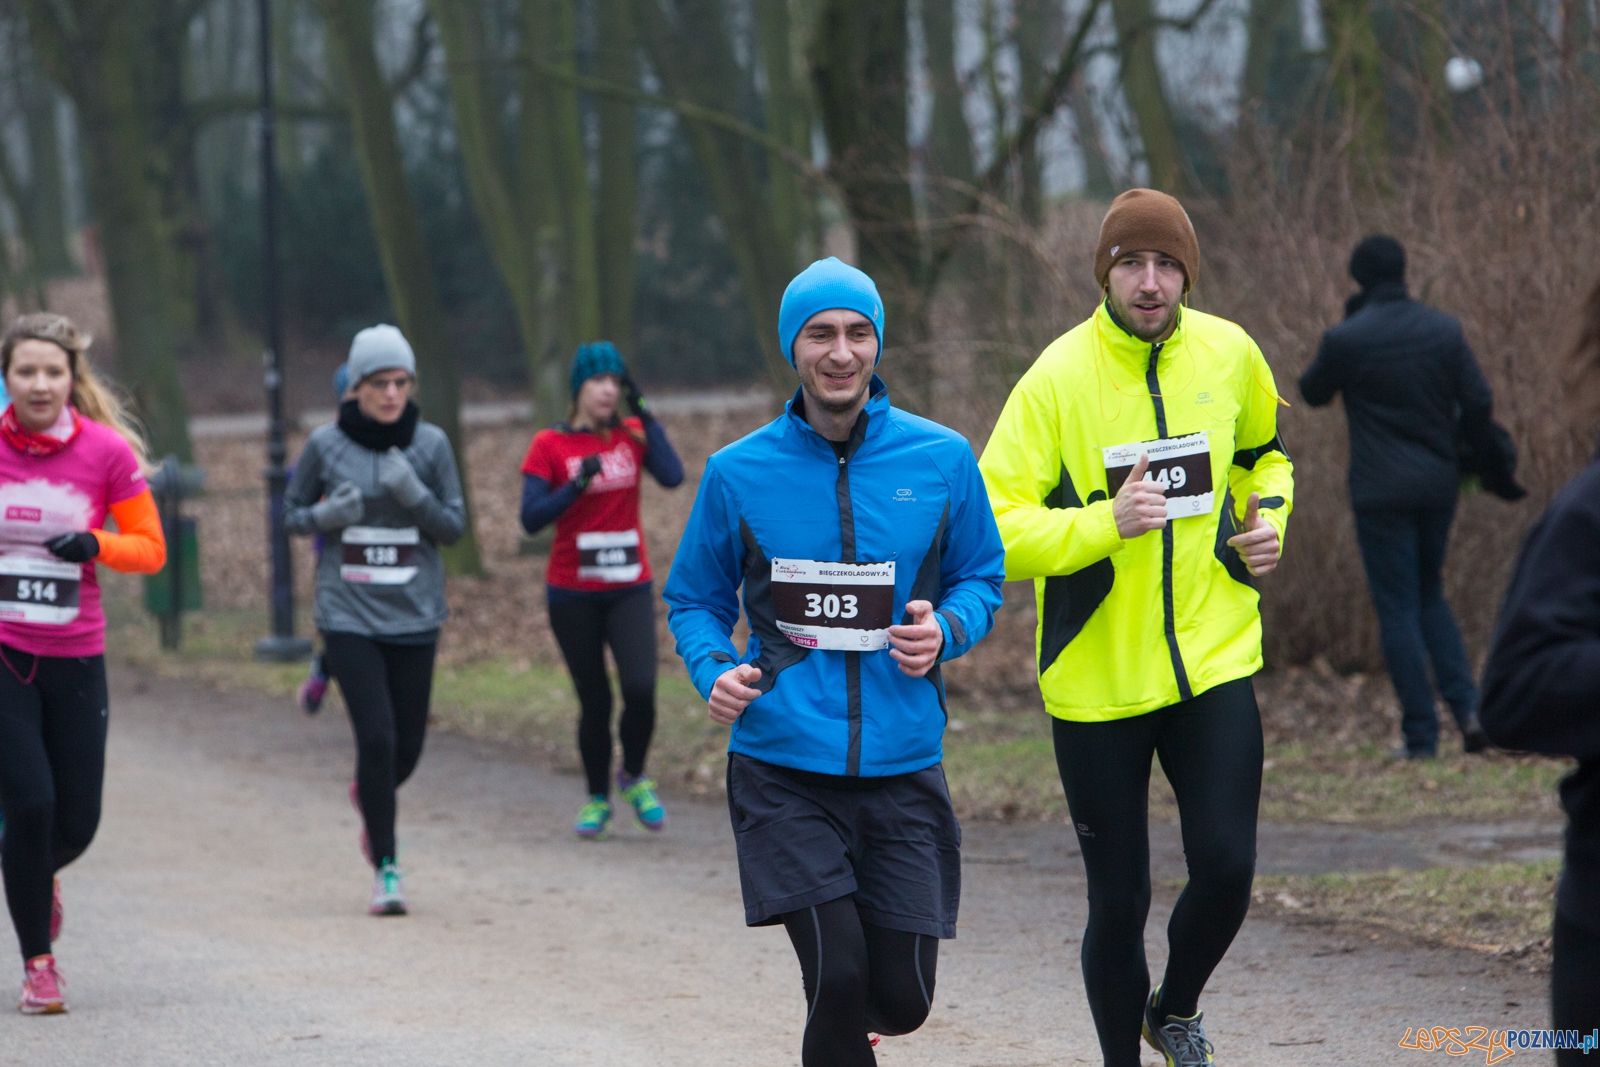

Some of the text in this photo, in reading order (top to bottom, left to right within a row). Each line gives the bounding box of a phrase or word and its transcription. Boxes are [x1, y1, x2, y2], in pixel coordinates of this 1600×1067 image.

[1147, 441, 1206, 454] BIEGCZEKOLADOWY.PL
[363, 546, 398, 565] 138
[17, 579, 58, 601] 514
[804, 593, 859, 619] 303
